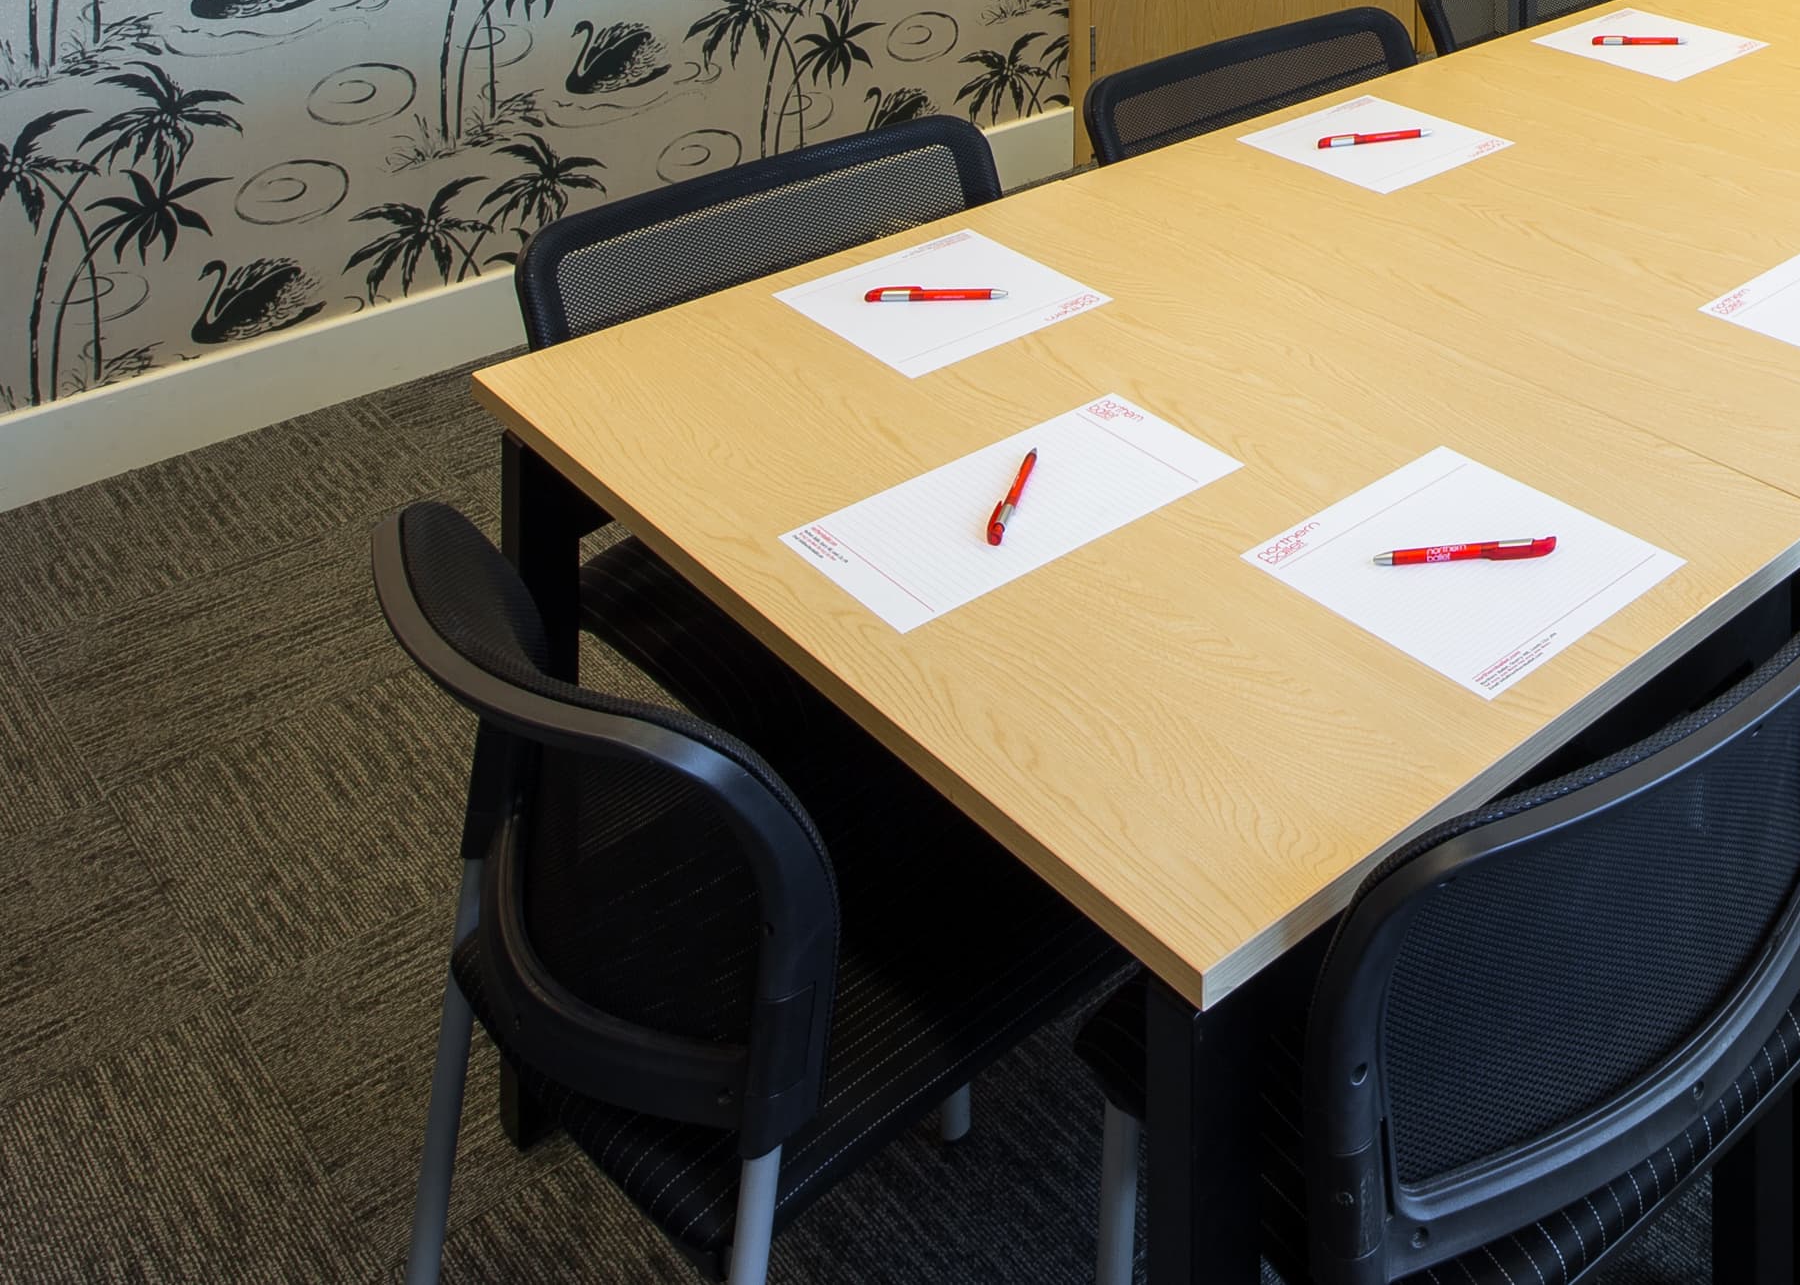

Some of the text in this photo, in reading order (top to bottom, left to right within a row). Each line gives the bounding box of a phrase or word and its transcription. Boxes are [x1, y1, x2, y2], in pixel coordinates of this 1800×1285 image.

[1257, 522, 1321, 561] northern
[1266, 539, 1305, 565] ballet
[1426, 544, 1467, 556] northern
